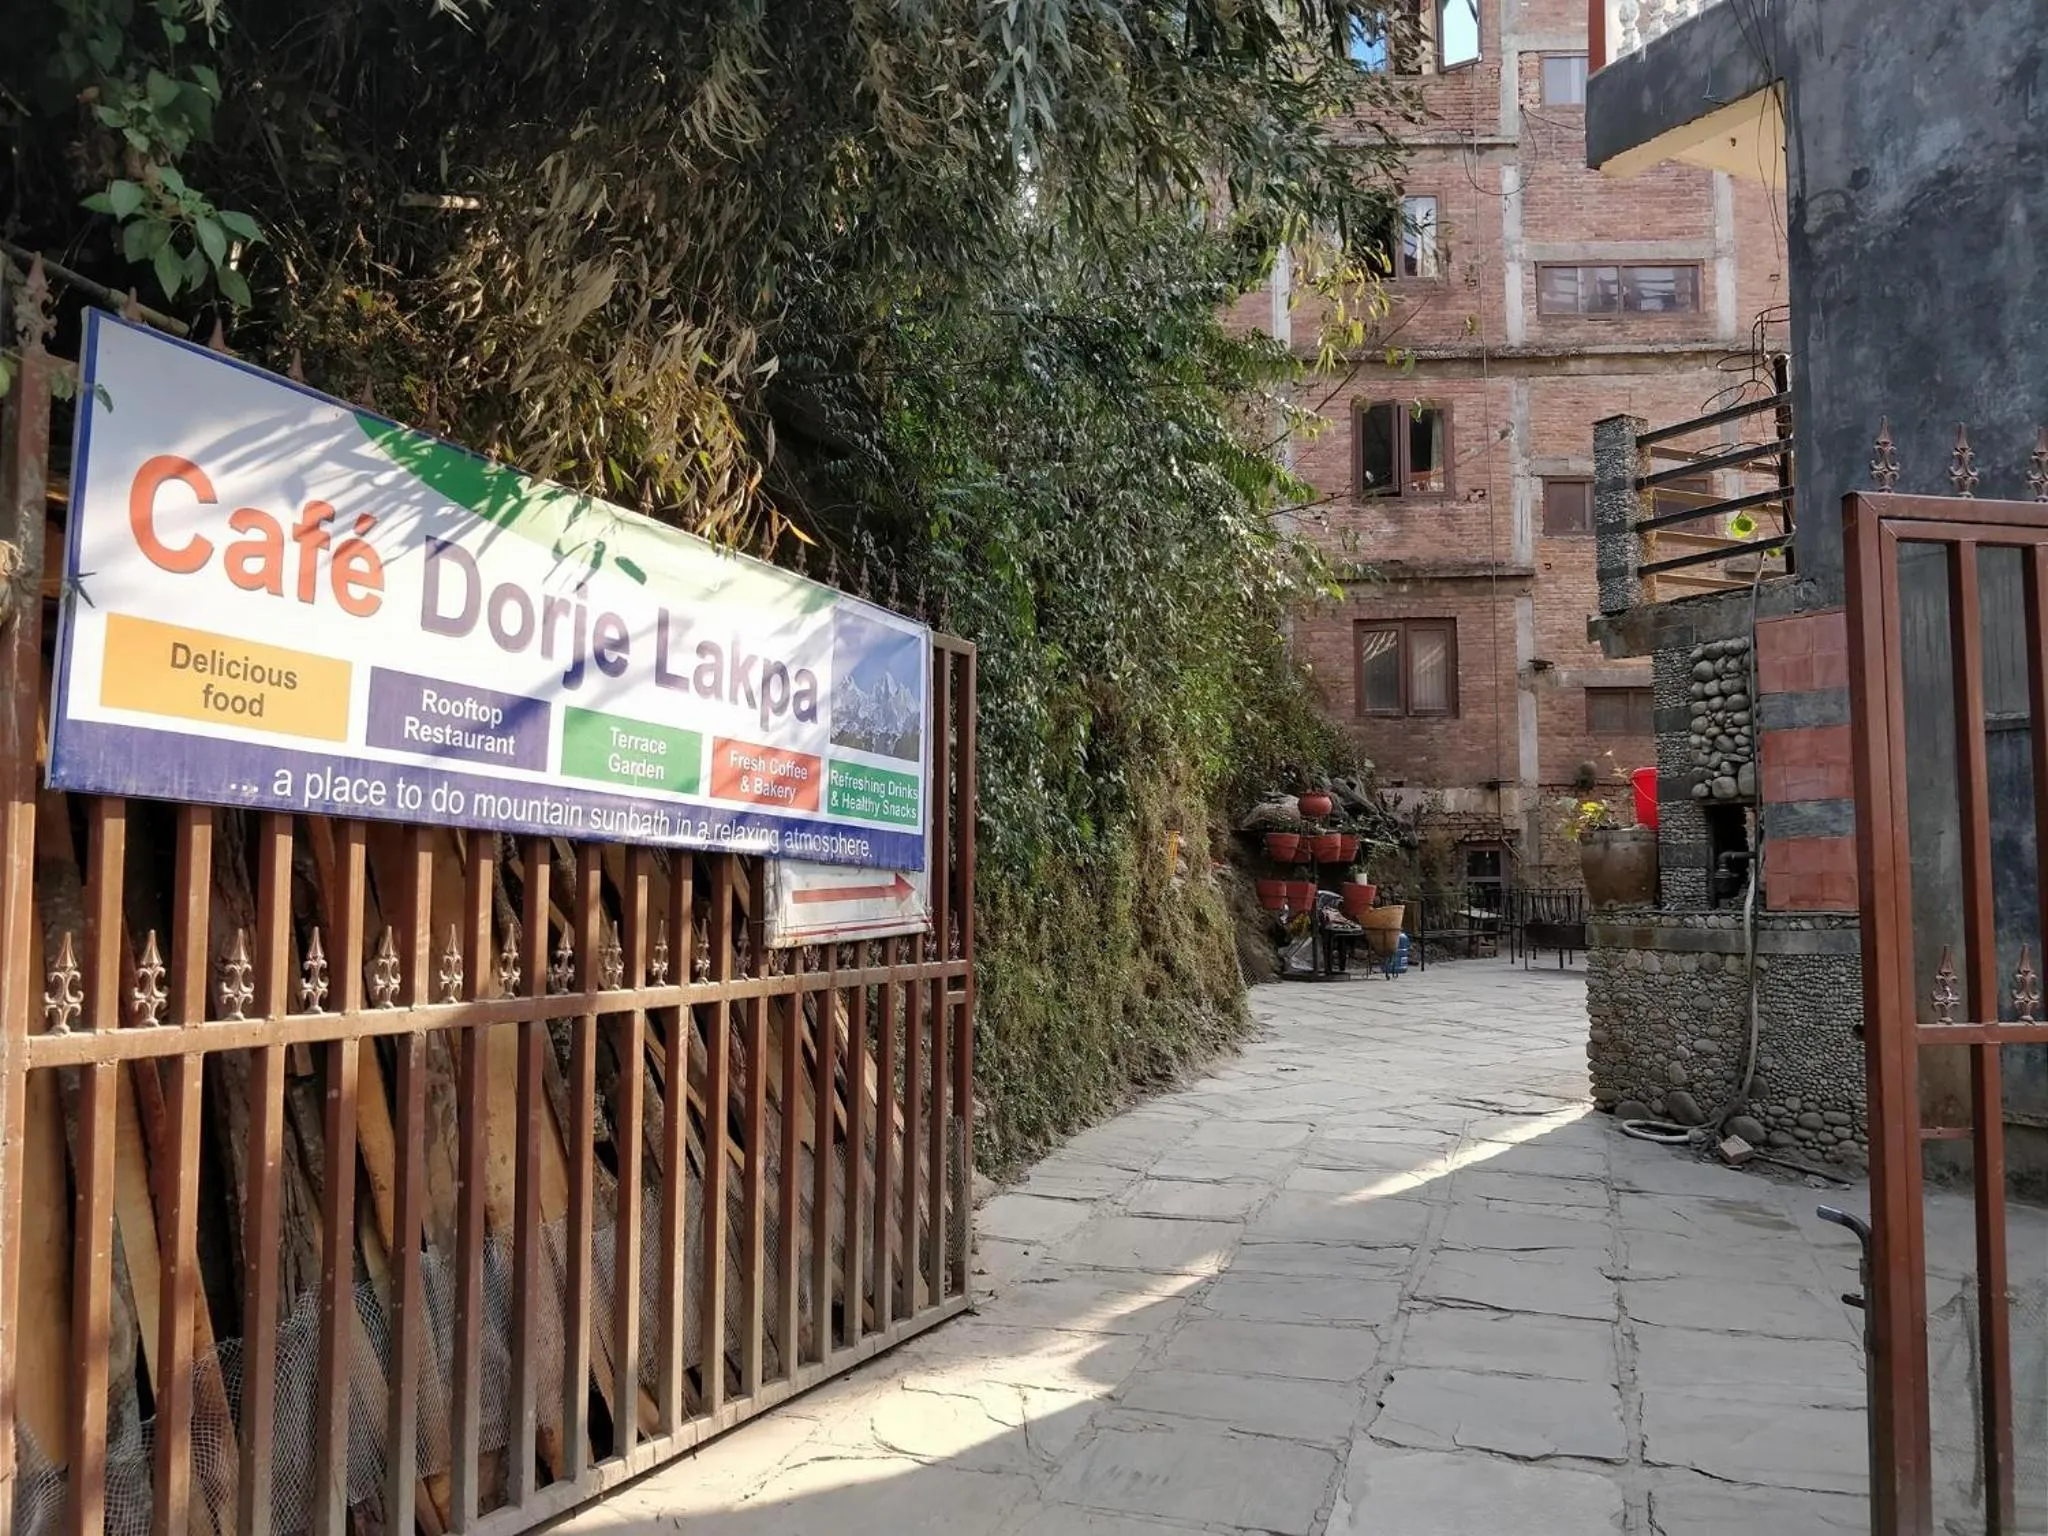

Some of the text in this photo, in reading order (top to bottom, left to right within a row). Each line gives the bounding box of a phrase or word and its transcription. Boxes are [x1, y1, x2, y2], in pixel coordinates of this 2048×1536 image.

[129, 454, 818, 731] Café Dorje Lakpa
[171, 642, 297, 690] Delicious
[202, 683, 264, 718] food
[422, 689, 502, 729] Rooftop
[404, 717, 515, 755] Restaurant
[610, 727, 666, 755] Terrace
[608, 755, 665, 781] Garden
[730, 750, 808, 780] Fresh Coffee
[740, 775, 796, 802] & Bakery
[831, 770, 919, 800] Refreshing Drinks
[273, 768, 291, 797] a
[304, 766, 387, 807] place
[397, 777, 422, 809] to
[432, 781, 464, 815] do
[473, 792, 582, 827] mountain
[589, 803, 669, 837] sunbath
[676, 812, 691, 838] in
[697, 821, 708, 841] a
[714, 819, 779, 854] relaxing
[784, 831, 873, 860] atmosphere.
[831, 790, 917, 819] & Healthy Snacks
